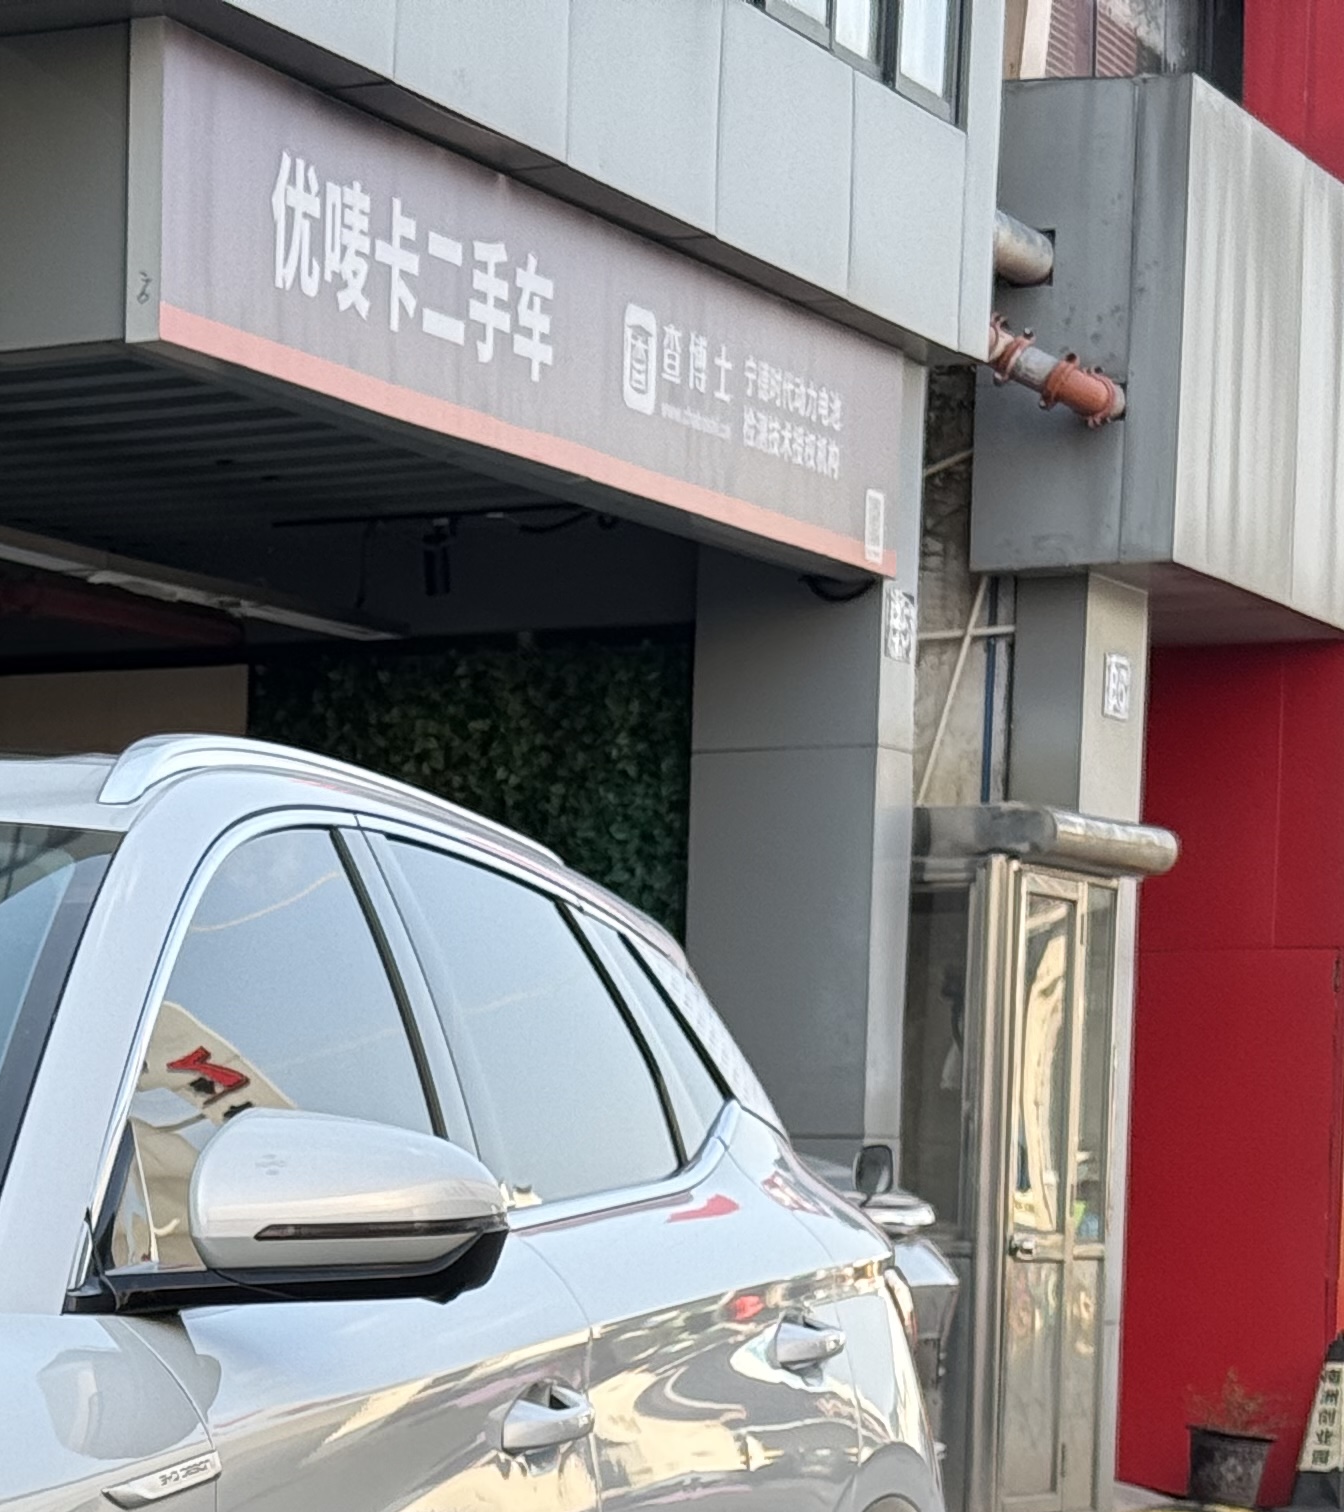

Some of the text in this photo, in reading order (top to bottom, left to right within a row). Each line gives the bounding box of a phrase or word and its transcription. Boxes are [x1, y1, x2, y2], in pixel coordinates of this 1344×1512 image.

[271, 151, 554, 382] 优唛卡二手车
[662, 324, 733, 402] 查博士
